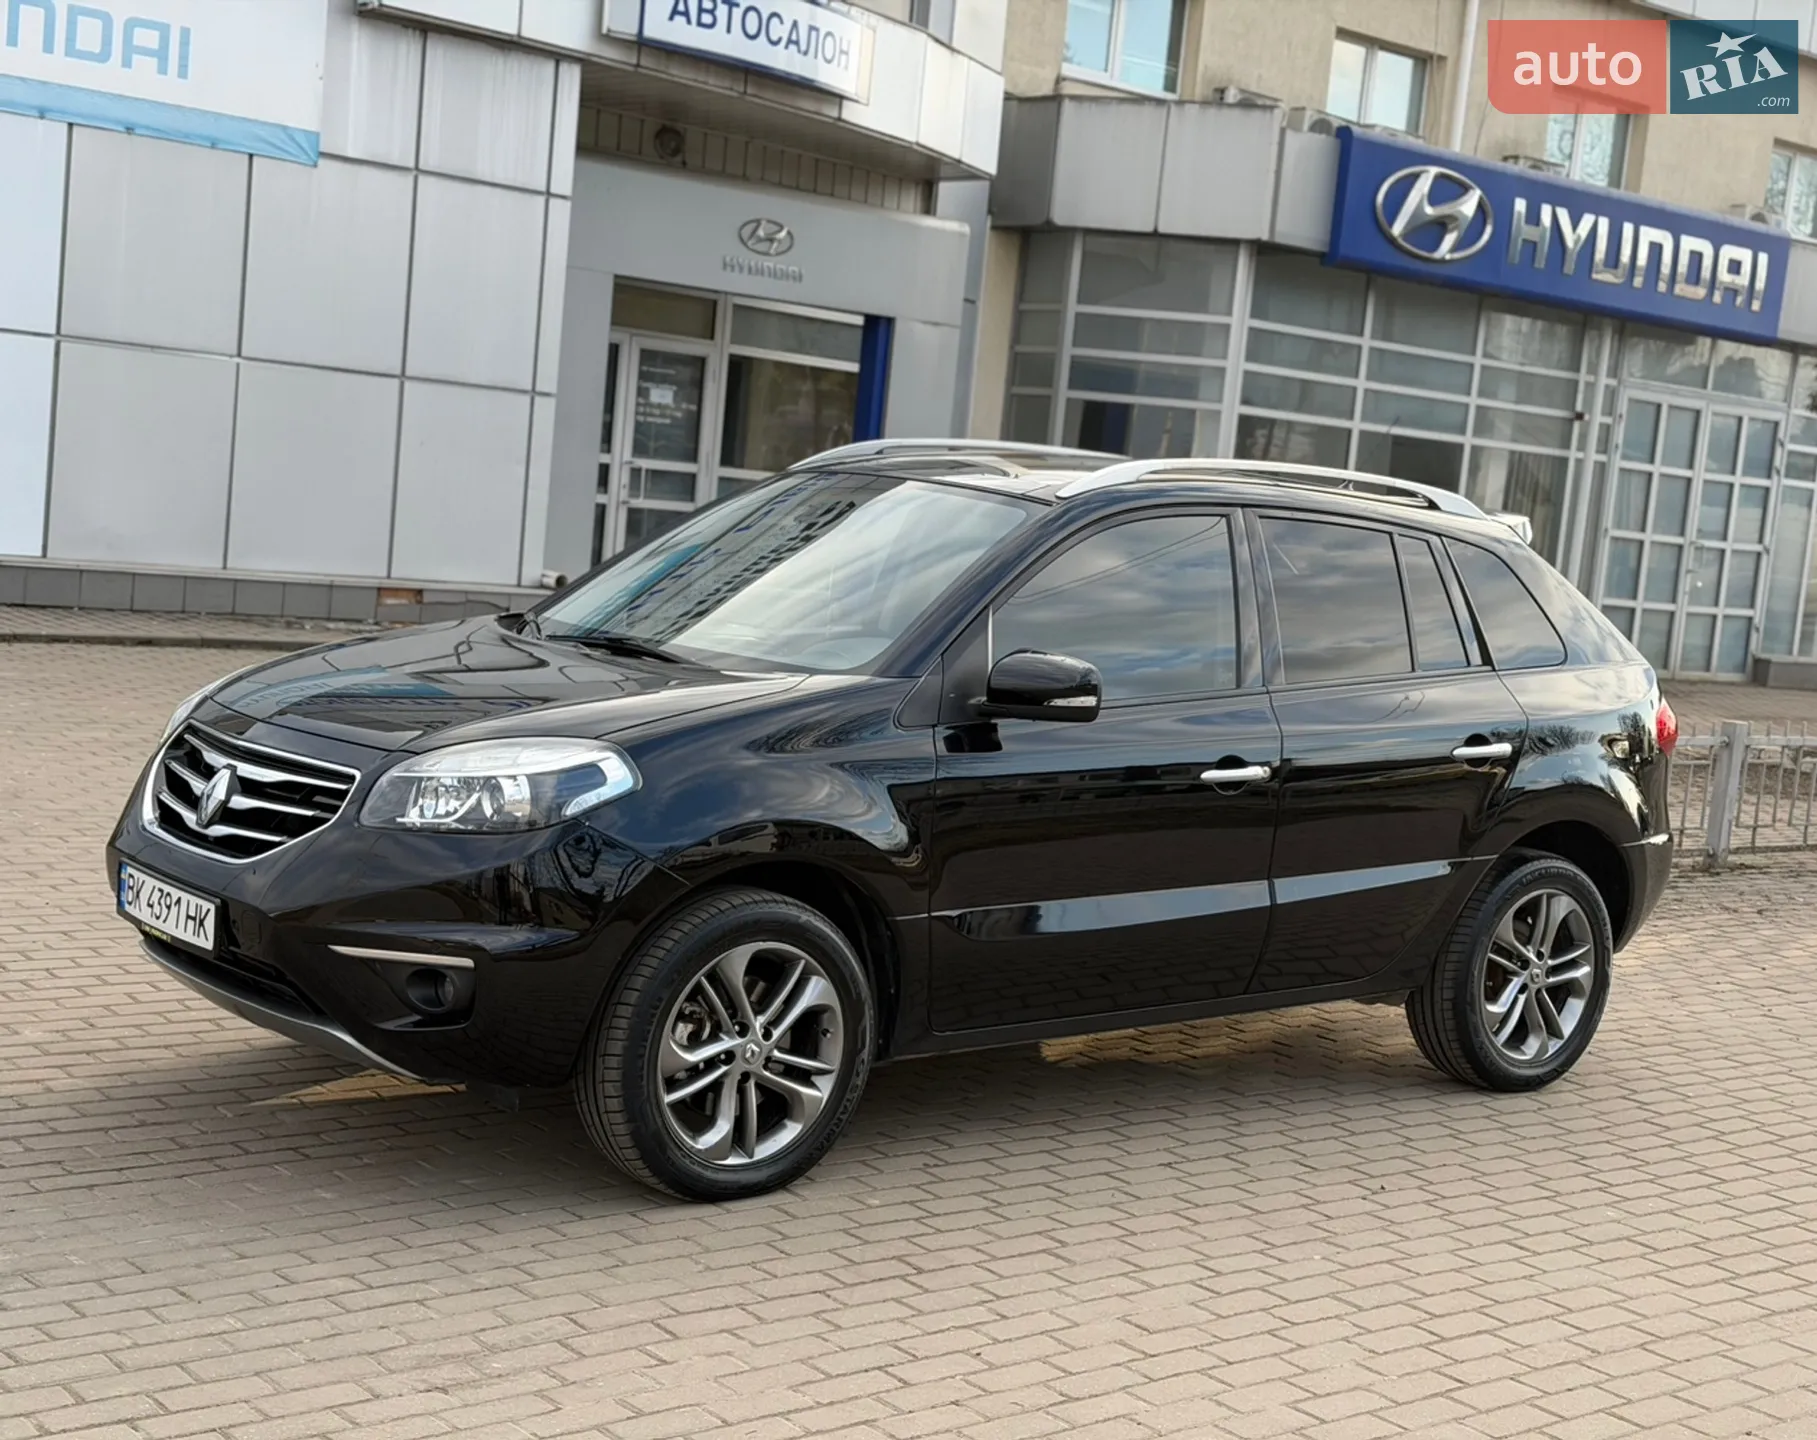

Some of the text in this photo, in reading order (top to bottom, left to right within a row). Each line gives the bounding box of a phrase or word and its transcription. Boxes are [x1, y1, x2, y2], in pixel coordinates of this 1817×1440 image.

[667, 0, 851, 70] АВТОСАЛОН
[721, 254, 804, 284] HYUNDAI
[1507, 196, 1769, 312] HYUNDAI
[127, 874, 145, 912] BK
[147, 885, 181, 929] 4391
[184, 900, 210, 941] HK
